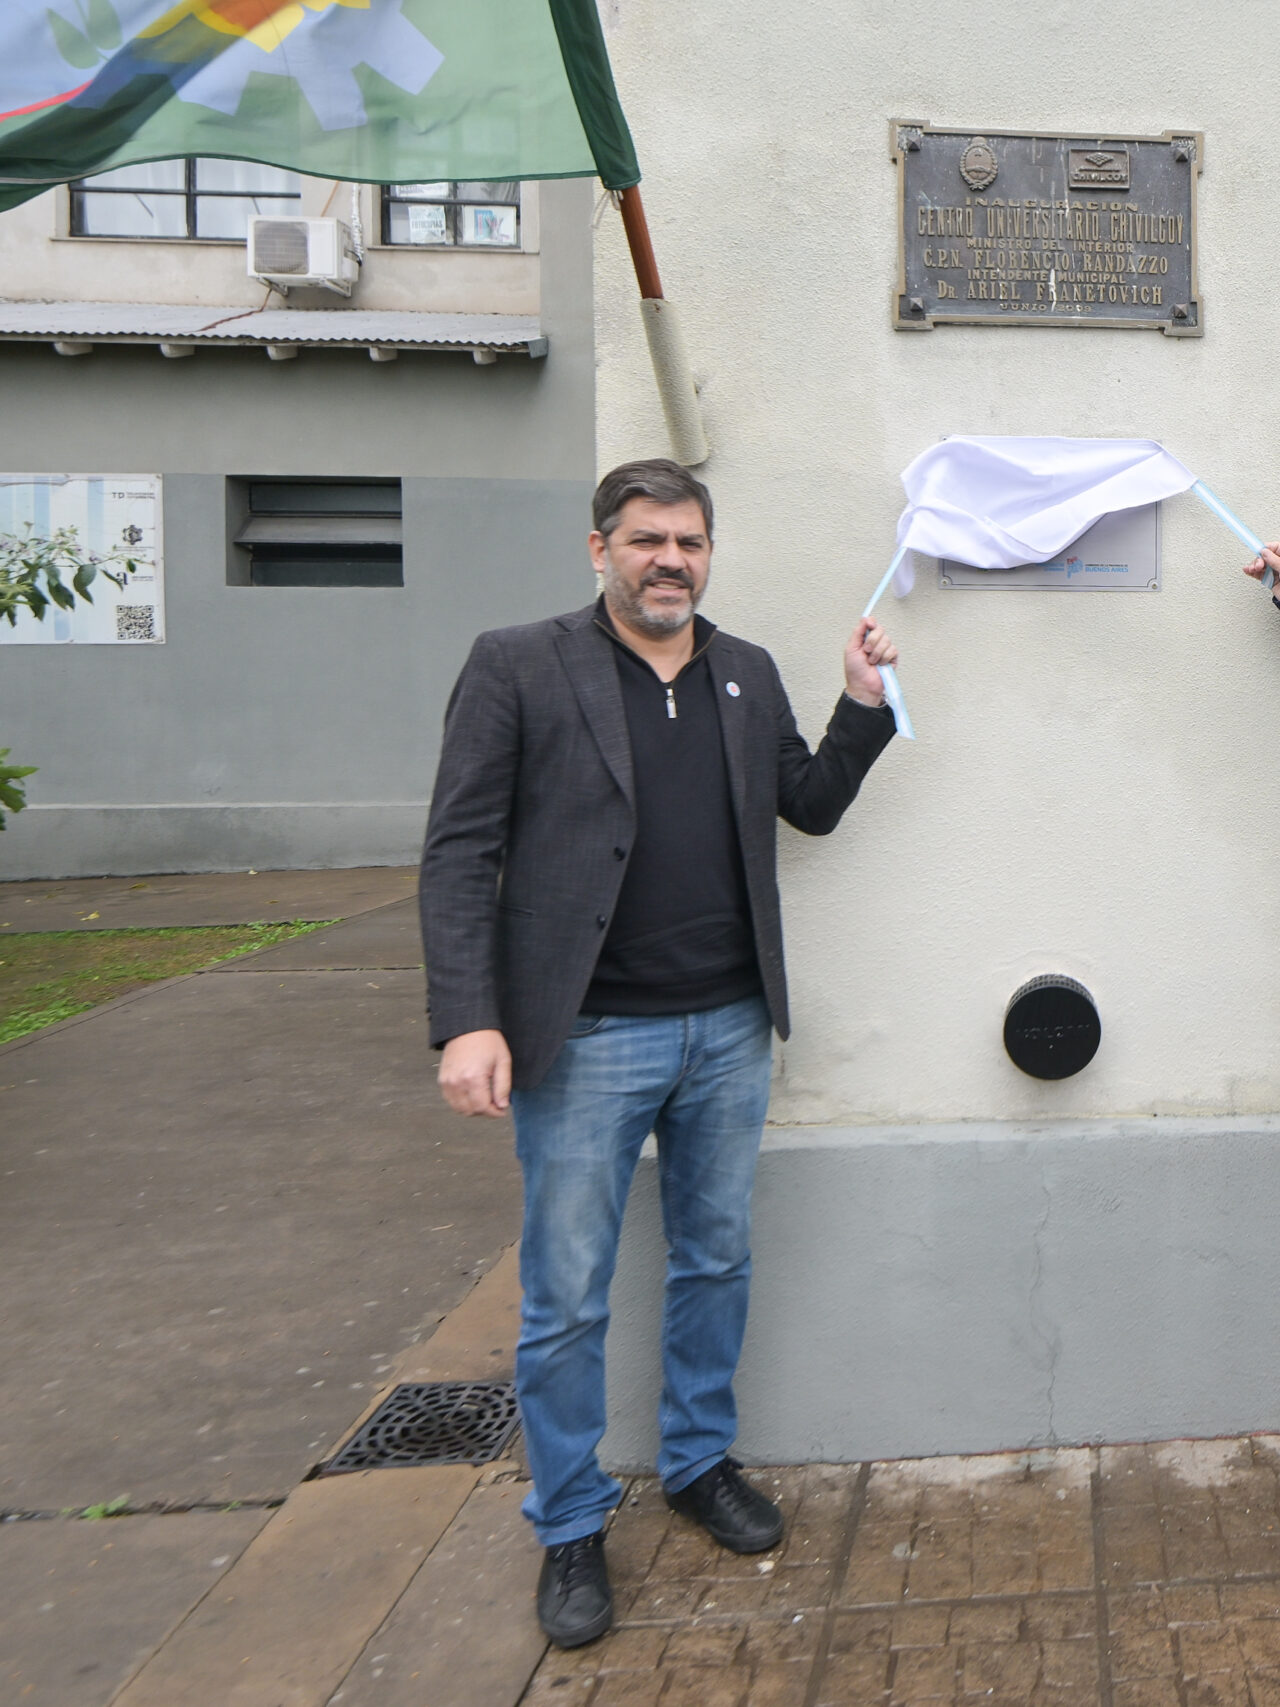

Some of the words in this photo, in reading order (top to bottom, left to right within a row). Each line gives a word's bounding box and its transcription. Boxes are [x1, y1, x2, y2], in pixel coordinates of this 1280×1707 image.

[1073, 172, 1128, 183] CHIVILCOY
[918, 206, 974, 238] CENTRO
[987, 207, 1099, 242] UNIVERSITARIO
[1110, 212, 1184, 245] CHIVILCOY
[967, 237, 1032, 250] MINISTRO
[1042, 239, 1066, 251] DEL
[1073, 241, 1136, 254] INTERIOR
[974, 249, 1070, 272] FLORENCIO
[1083, 253, 1169, 275] RANDAZZO
[967, 269, 1049, 282] INTENDENTE
[1058, 272, 1127, 285] MUNICIPAL
[967, 280, 1021, 301] ARIEL
[1000, 302, 1048, 312] JUNIO
[1056, 303, 1092, 313] 2009
